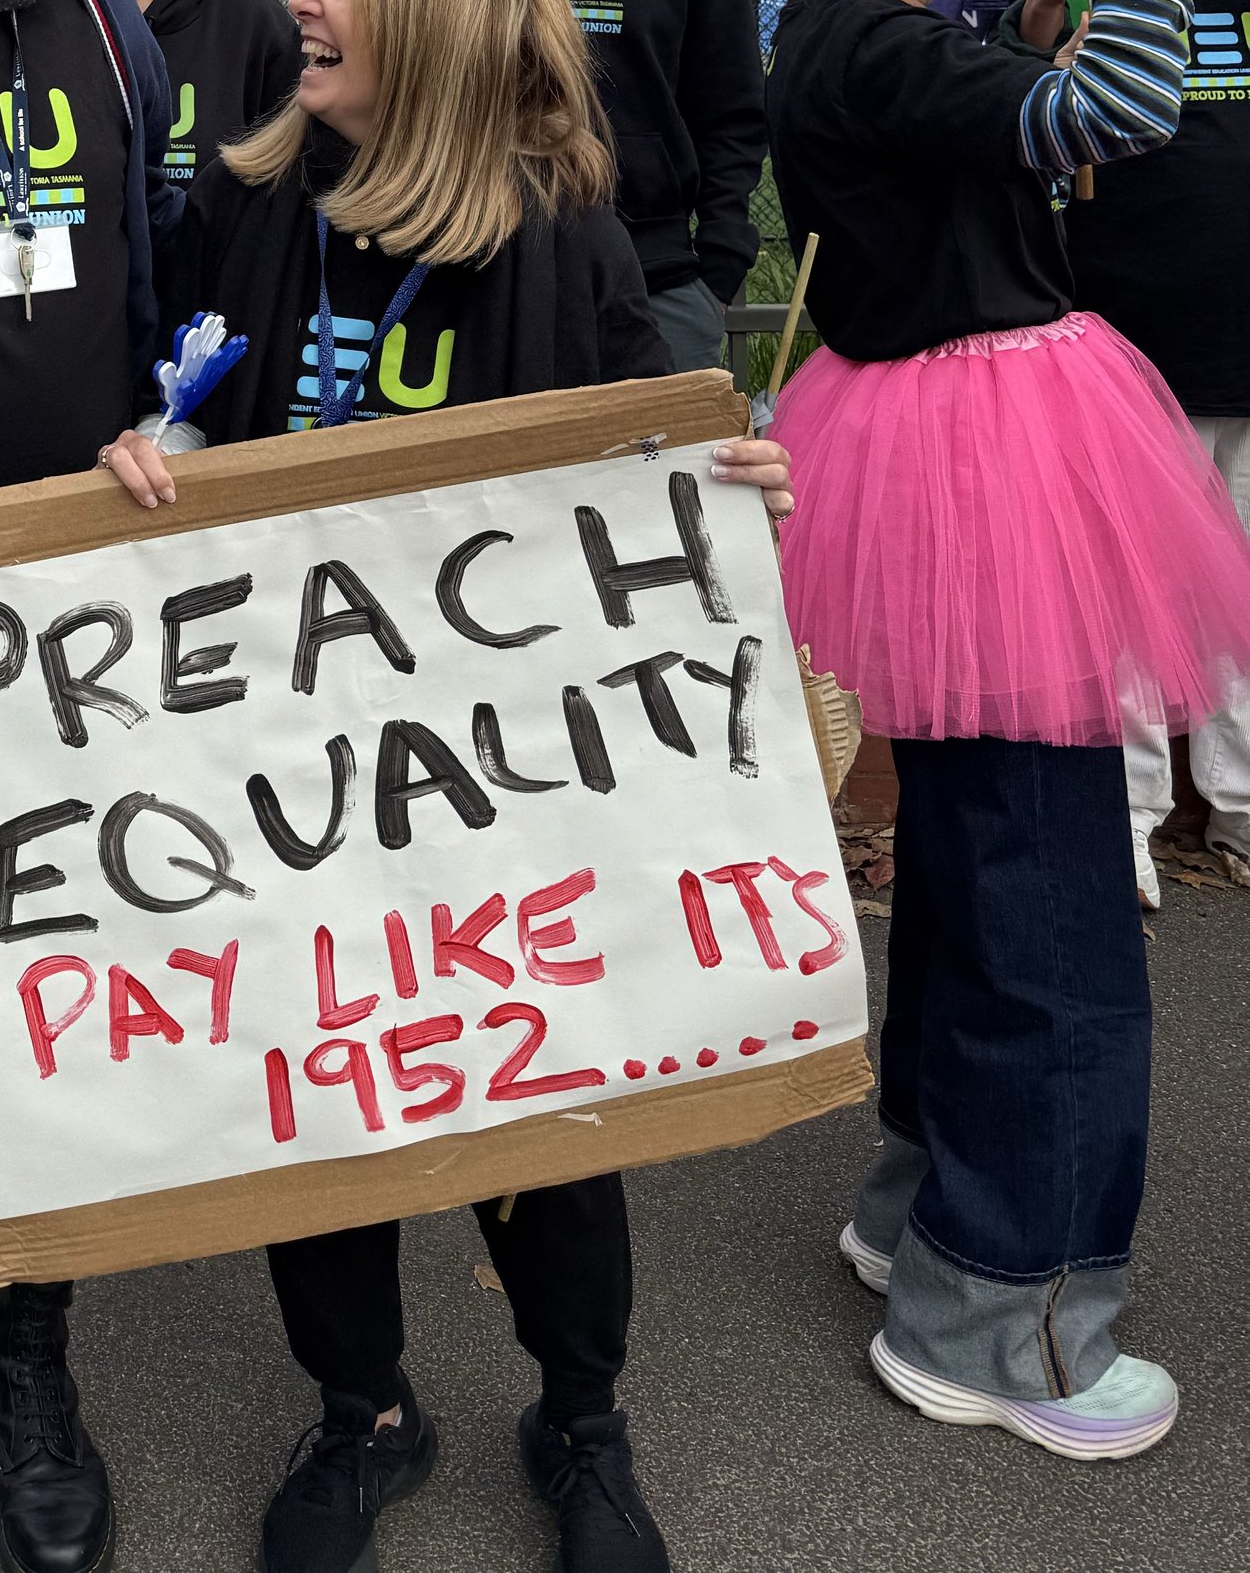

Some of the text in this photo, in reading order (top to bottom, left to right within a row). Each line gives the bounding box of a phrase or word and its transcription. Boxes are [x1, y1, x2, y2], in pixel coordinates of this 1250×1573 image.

[581, 21, 623, 34] UNION
[1182, 90, 1227, 101] PROUD
[1228, 89, 1246, 100] TO
[15, 938, 241, 1081] PAY
[314, 867, 607, 1029] LIKE
